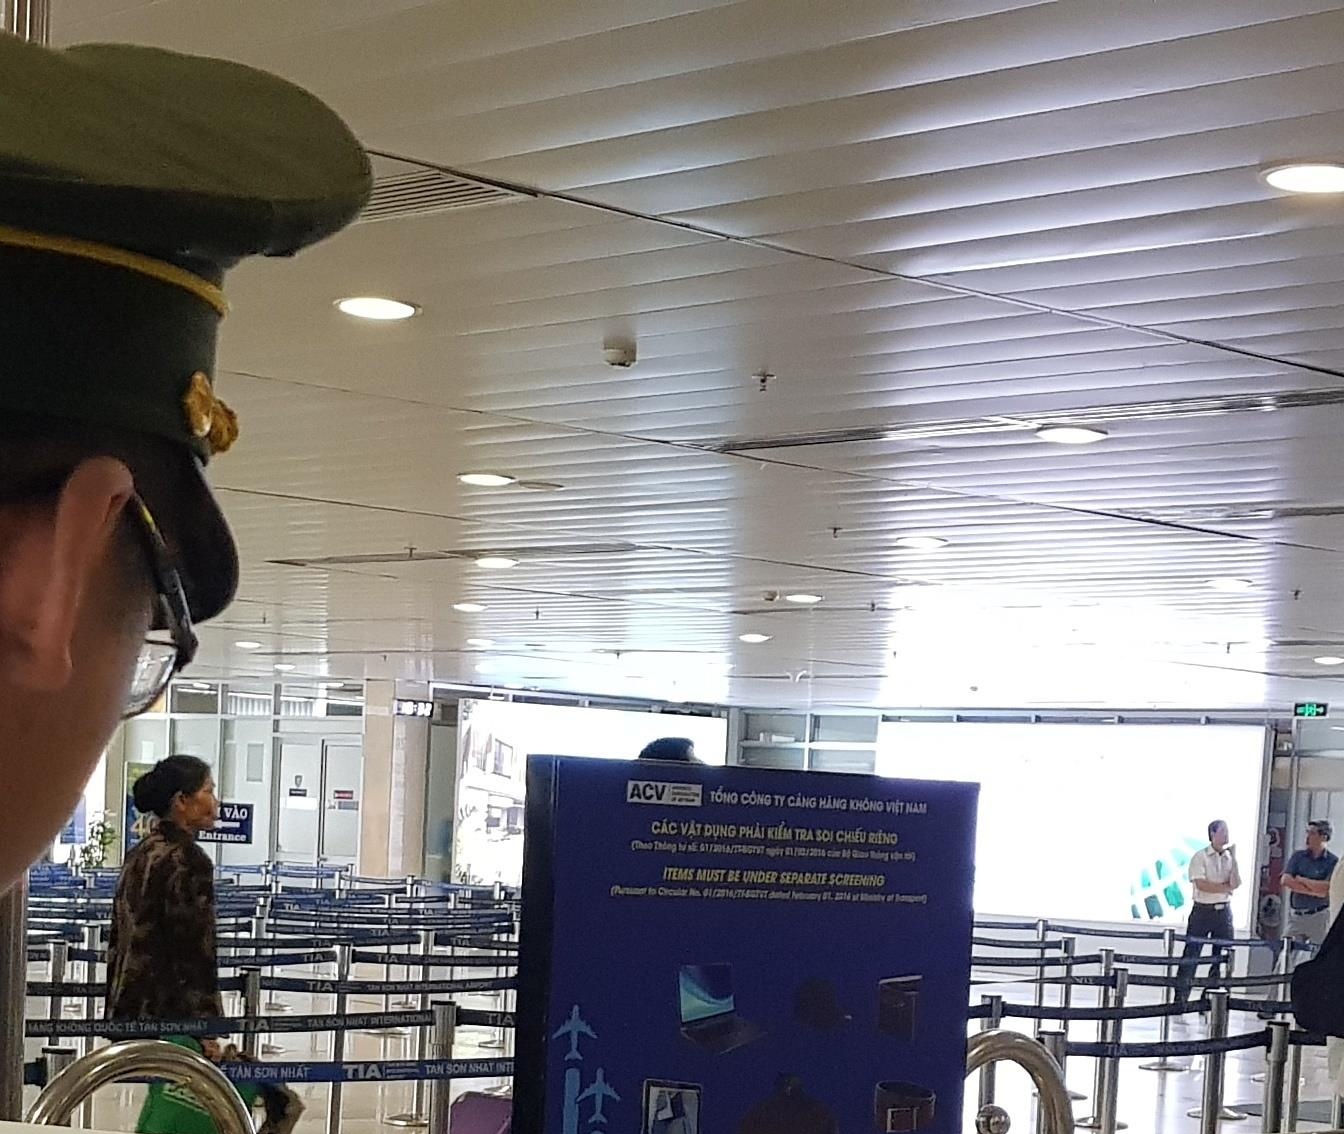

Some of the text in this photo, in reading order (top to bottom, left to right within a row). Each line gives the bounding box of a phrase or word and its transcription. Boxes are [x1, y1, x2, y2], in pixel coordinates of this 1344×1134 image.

[630, 783, 666, 800] ACV
[224, 806, 248, 820] VÀO
[774, 795, 785, 804] TY
[905, 802, 927, 814] NAM
[198, 830, 247, 843] Entrance
[651, 818, 678, 834] CÁC
[680, 820, 702, 839] VẬT
[704, 825, 737, 840] DỤNG
[767, 820, 793, 840] KIỂM
[794, 829, 814, 841] TRA
[816, 830, 833, 842] SOI
[663, 867, 885, 887] ITEMS MUST BE UNDER SEPARATE SCREENING
[307, 981, 334, 991] TIA
[236, 1018, 269, 1031] TIA
[343, 1064, 383, 1079] TIA
[425, 1064, 444, 1076] TAN
[445, 1063, 467, 1075] SON
[469, 1062, 495, 1074] NHAT
